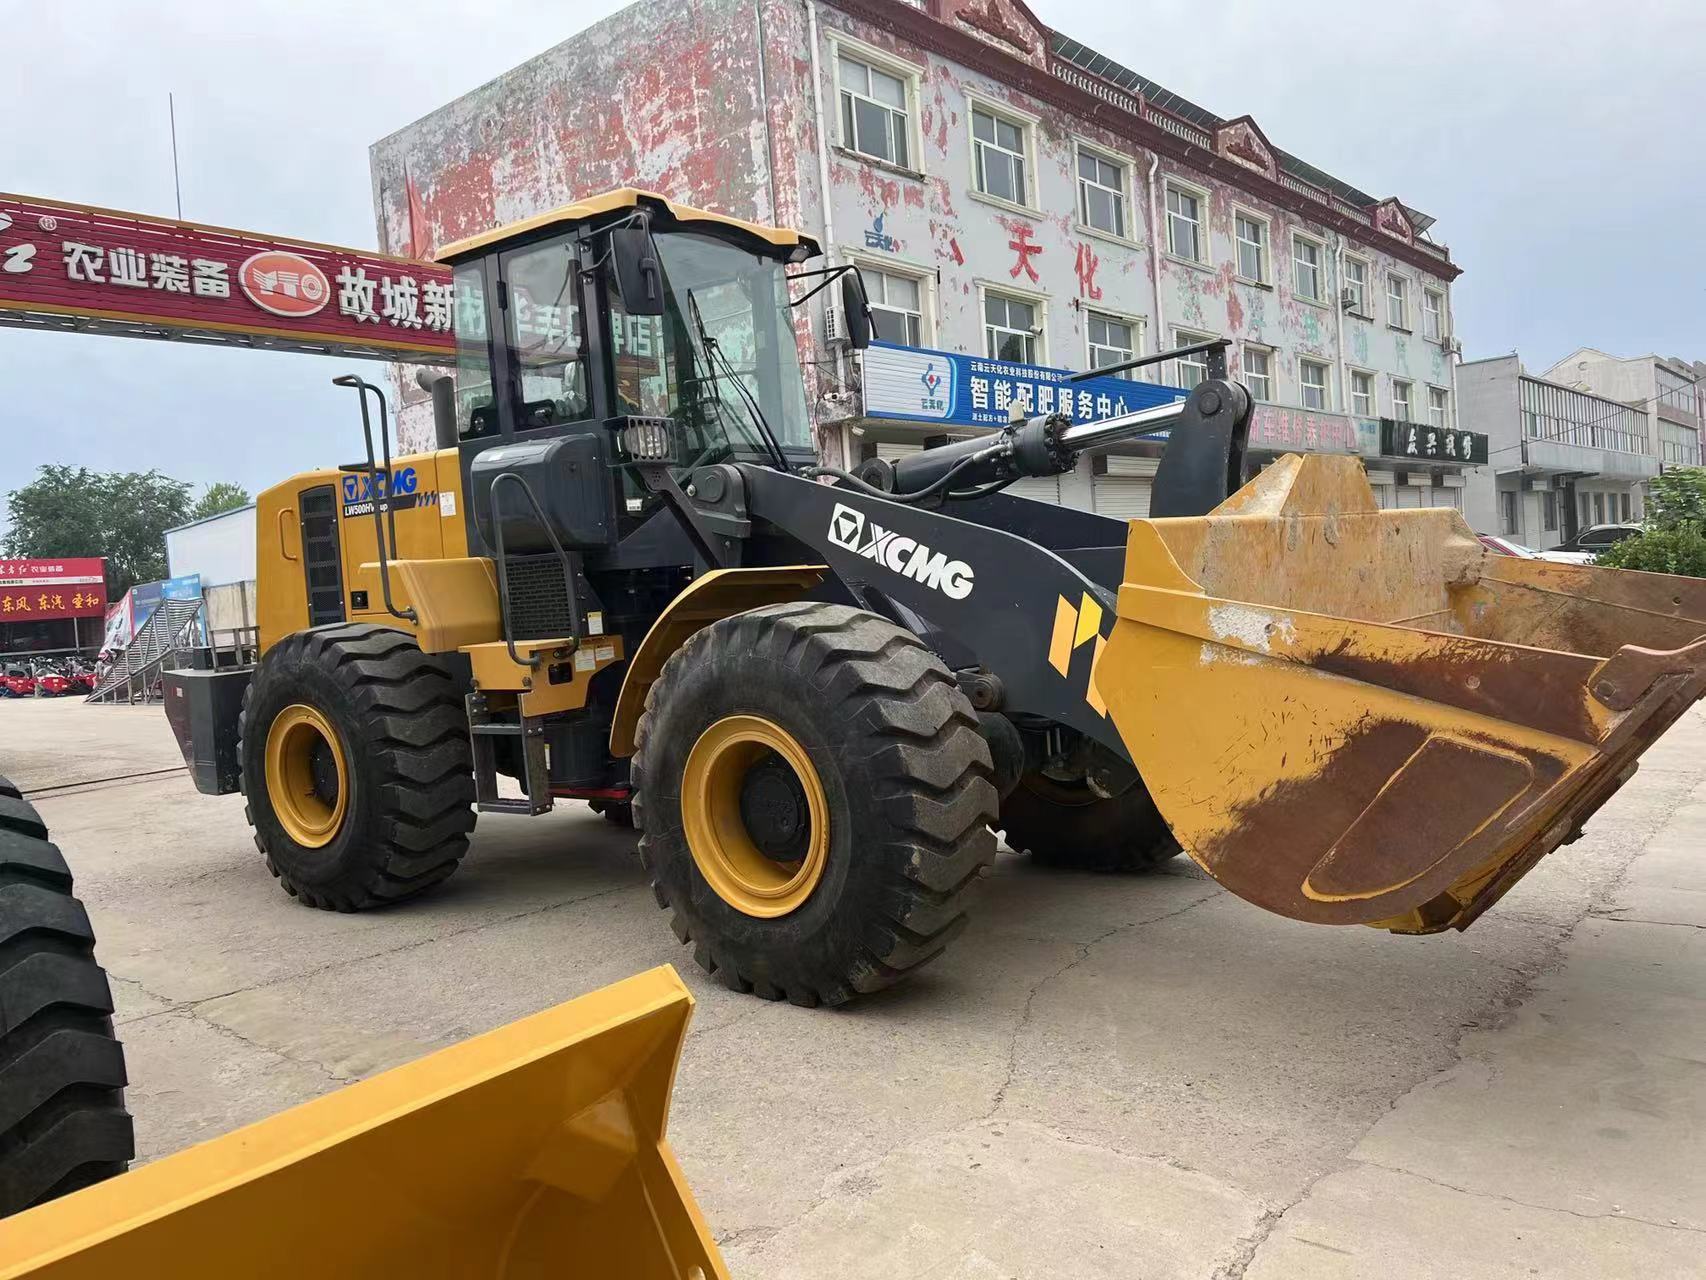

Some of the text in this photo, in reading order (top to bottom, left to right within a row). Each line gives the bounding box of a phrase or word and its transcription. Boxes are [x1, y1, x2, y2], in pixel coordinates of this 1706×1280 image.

[62, 241, 230, 298] 农业装备
[970, 376, 1129, 420] 智能配肥服务中心
[857, 522, 974, 600] XCMG
[2, 595, 31, 612] 东风
